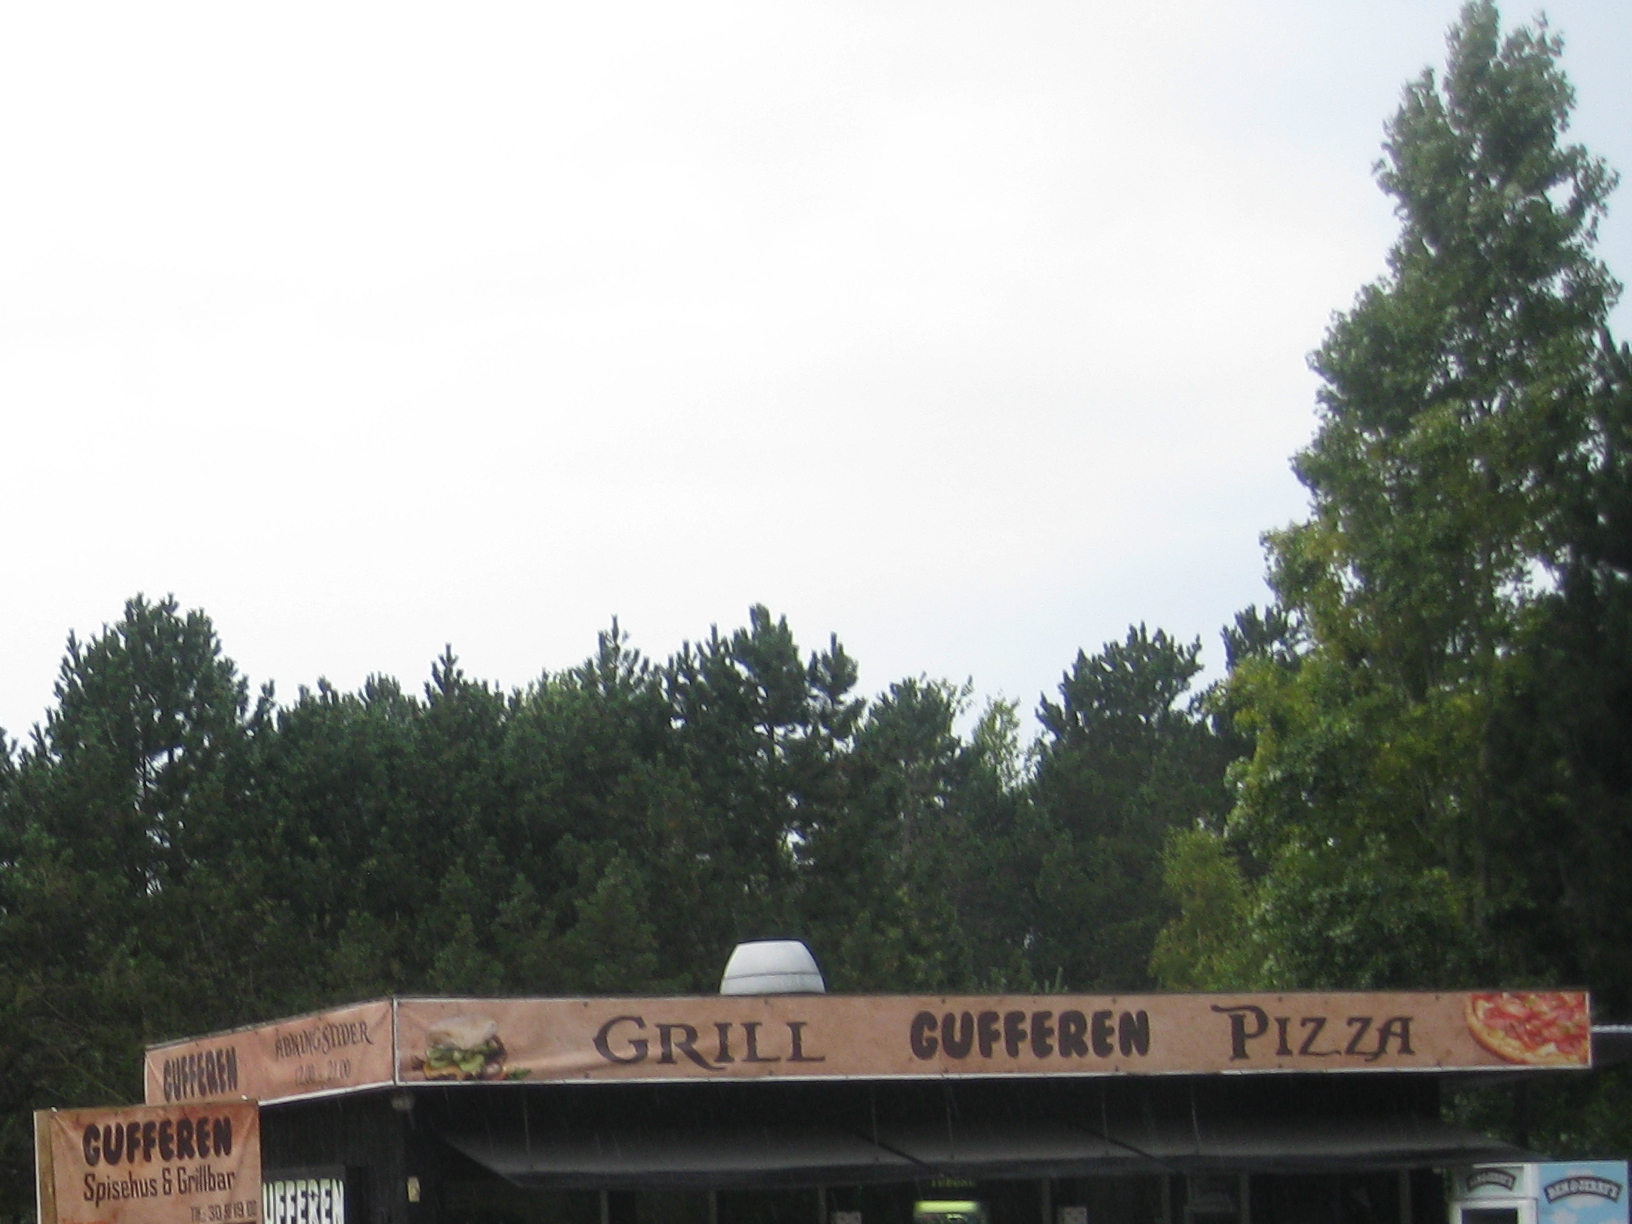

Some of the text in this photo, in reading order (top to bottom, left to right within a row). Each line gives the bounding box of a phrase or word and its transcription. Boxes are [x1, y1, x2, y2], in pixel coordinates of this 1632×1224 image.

[592, 1015, 827, 1070] GRILL
[909, 1010, 1151, 1060] GUFFEREN
[1211, 1004, 1416, 1061] PIZZA
[163, 1047, 238, 1101] GUFFEREN
[82, 1116, 233, 1167] GUFFEREN
[83, 1164, 236, 1208] Spisehus & Grillbar
